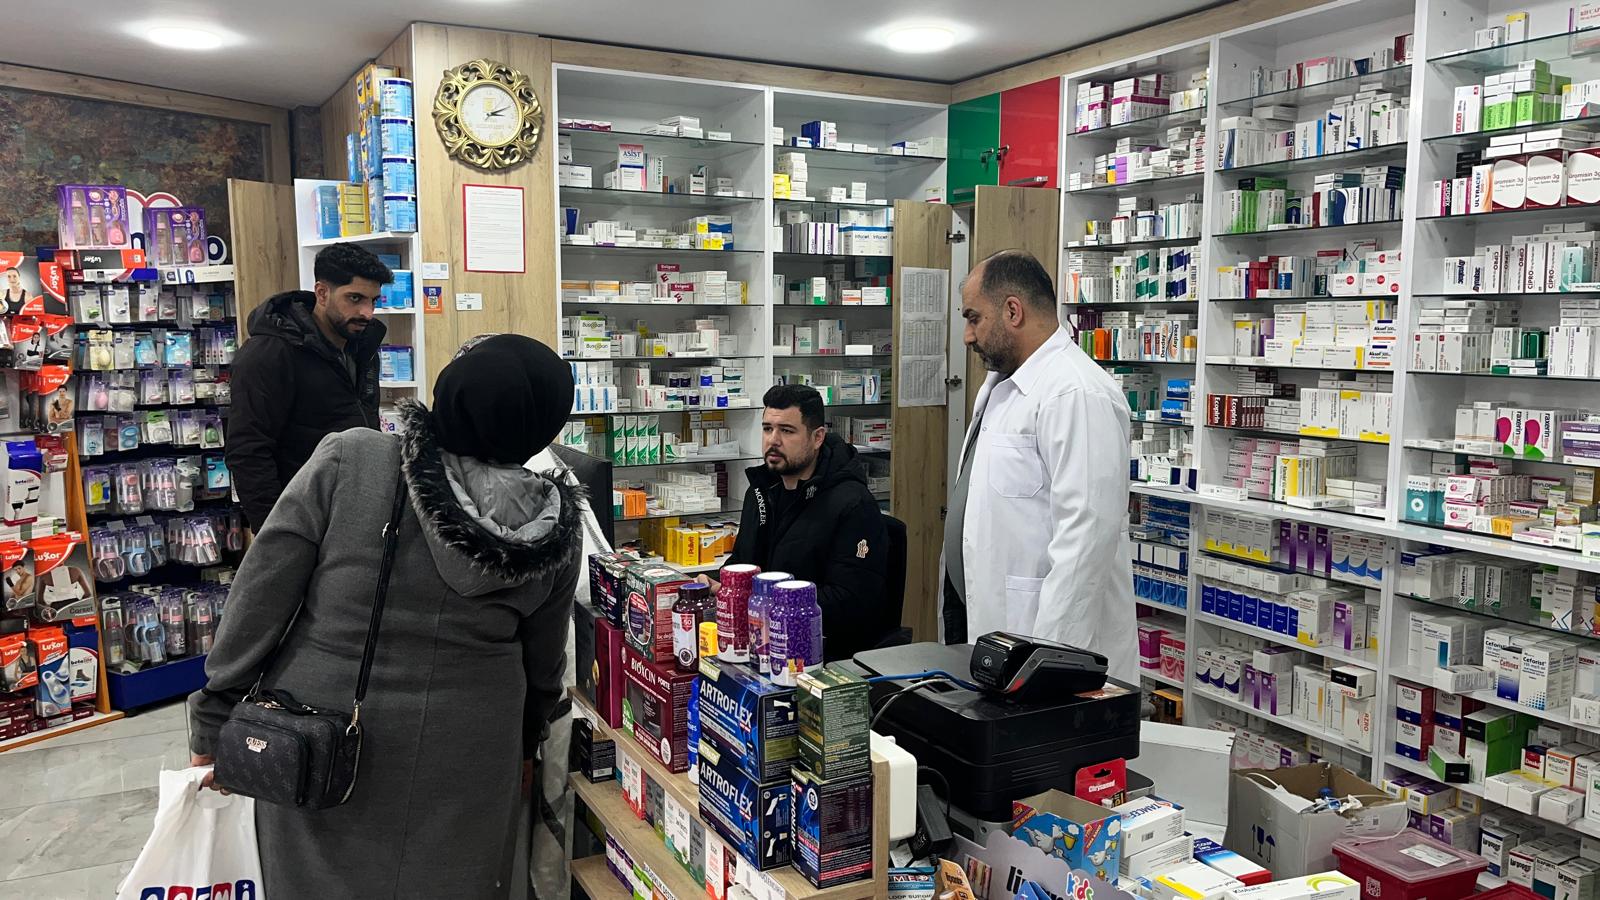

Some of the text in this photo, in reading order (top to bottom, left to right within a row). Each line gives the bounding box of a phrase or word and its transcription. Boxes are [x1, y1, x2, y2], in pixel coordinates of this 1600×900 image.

[1230, 398, 1238, 425] Ecopirin
[754, 487, 767, 526] MONCLER
[700, 680, 752, 730] ARTROFLEX
[700, 762, 752, 820] ARTROFLEX
[1129, 802, 1162, 819] TAMCEF
